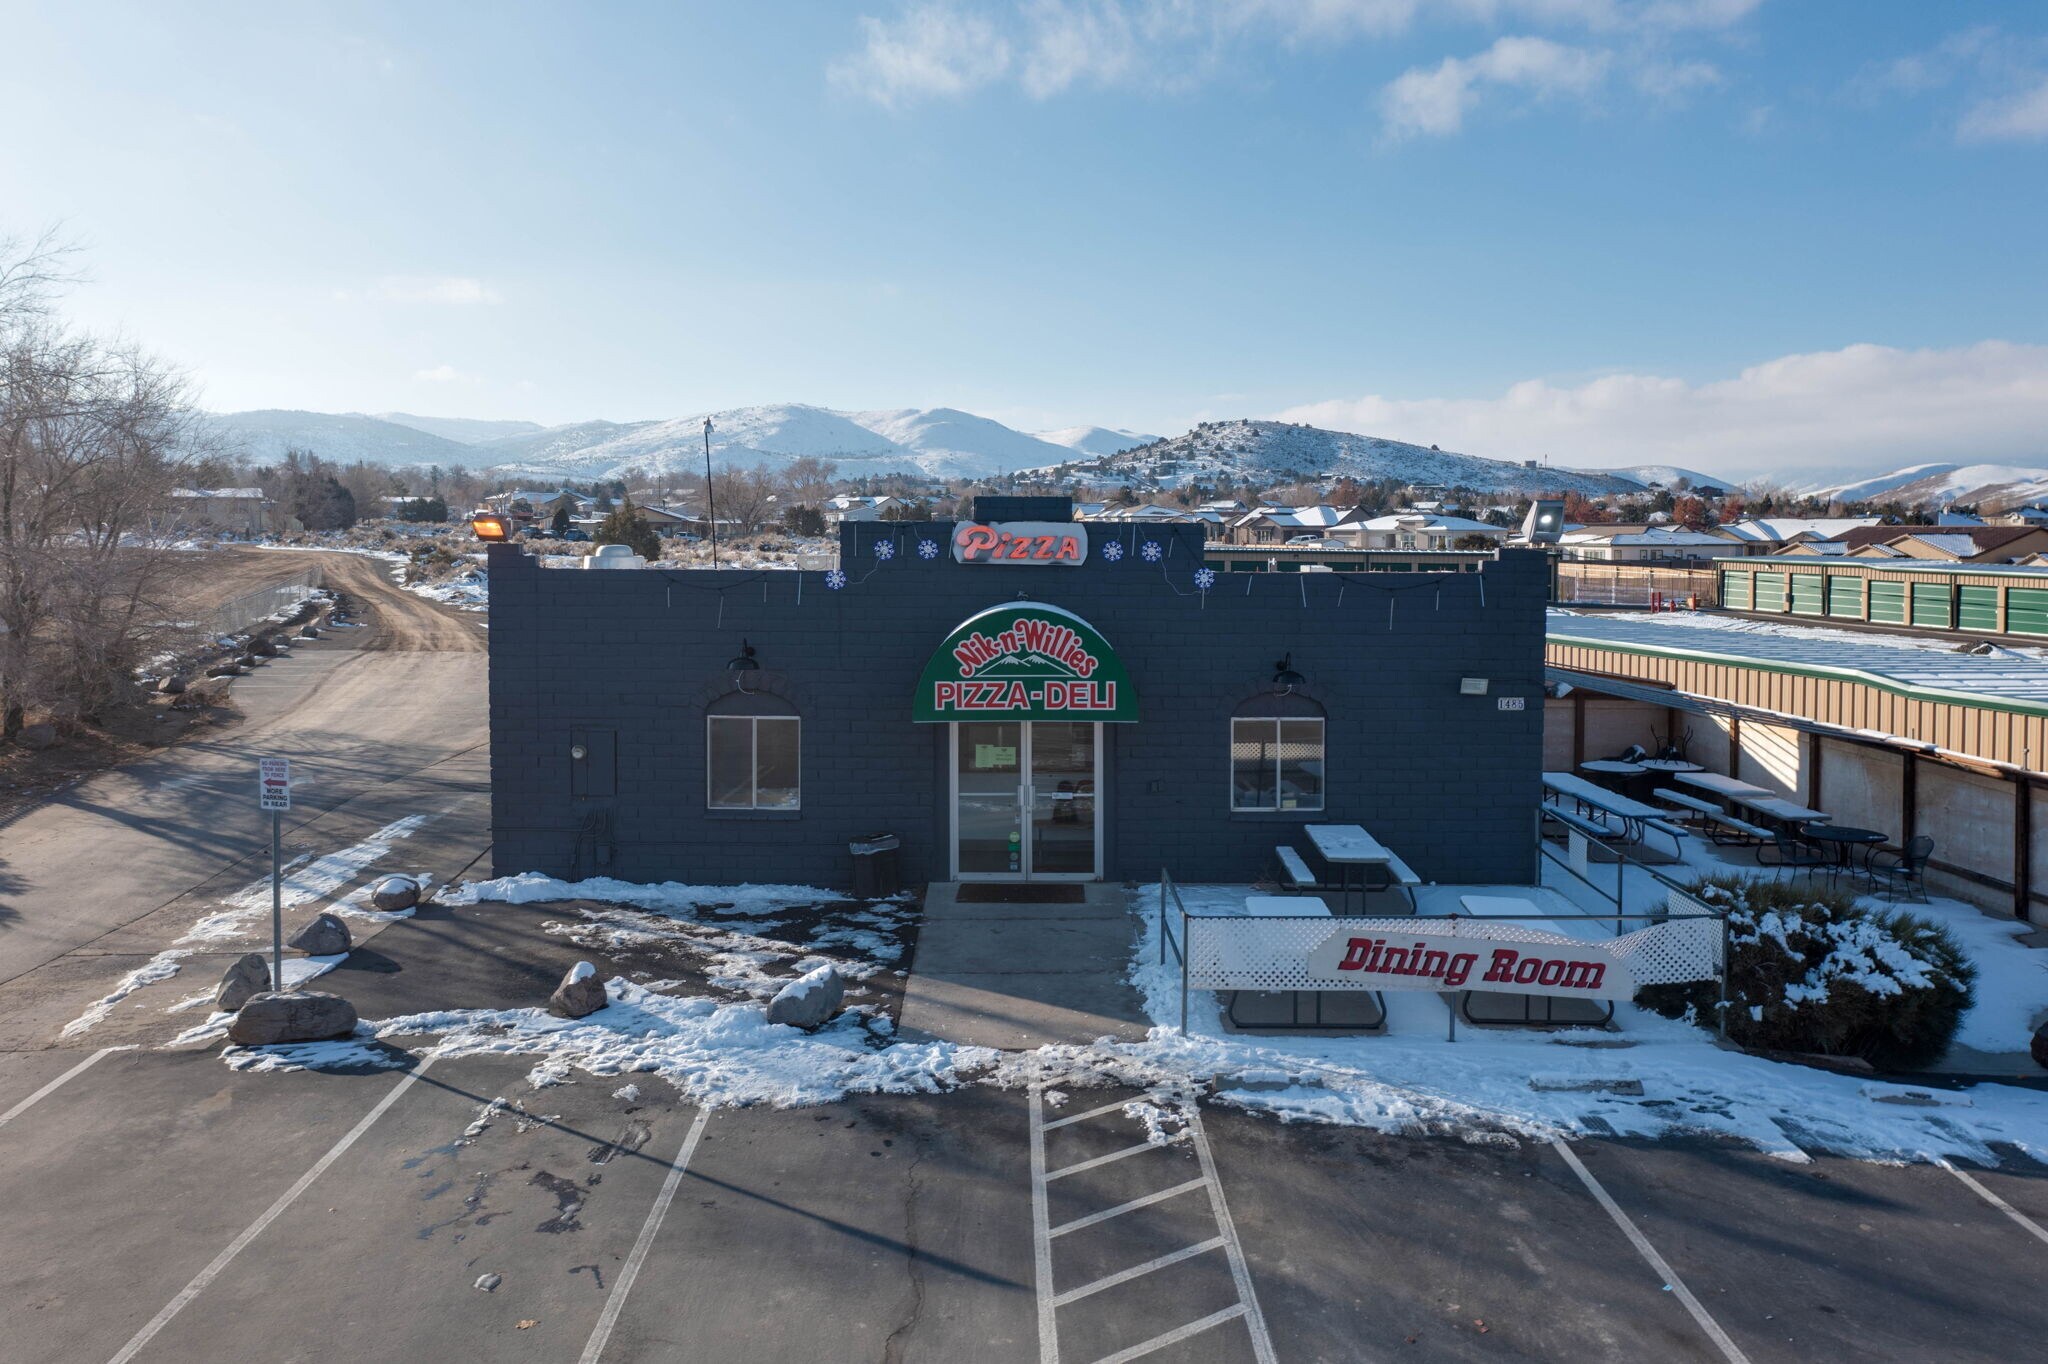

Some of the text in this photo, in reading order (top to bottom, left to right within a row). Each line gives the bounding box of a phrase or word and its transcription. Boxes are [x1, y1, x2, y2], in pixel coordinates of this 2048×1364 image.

[953, 618, 1098, 679] Nik-n-Willies
[1500, 699, 1524, 709] 1485
[1337, 937, 1607, 989] Dining Room
